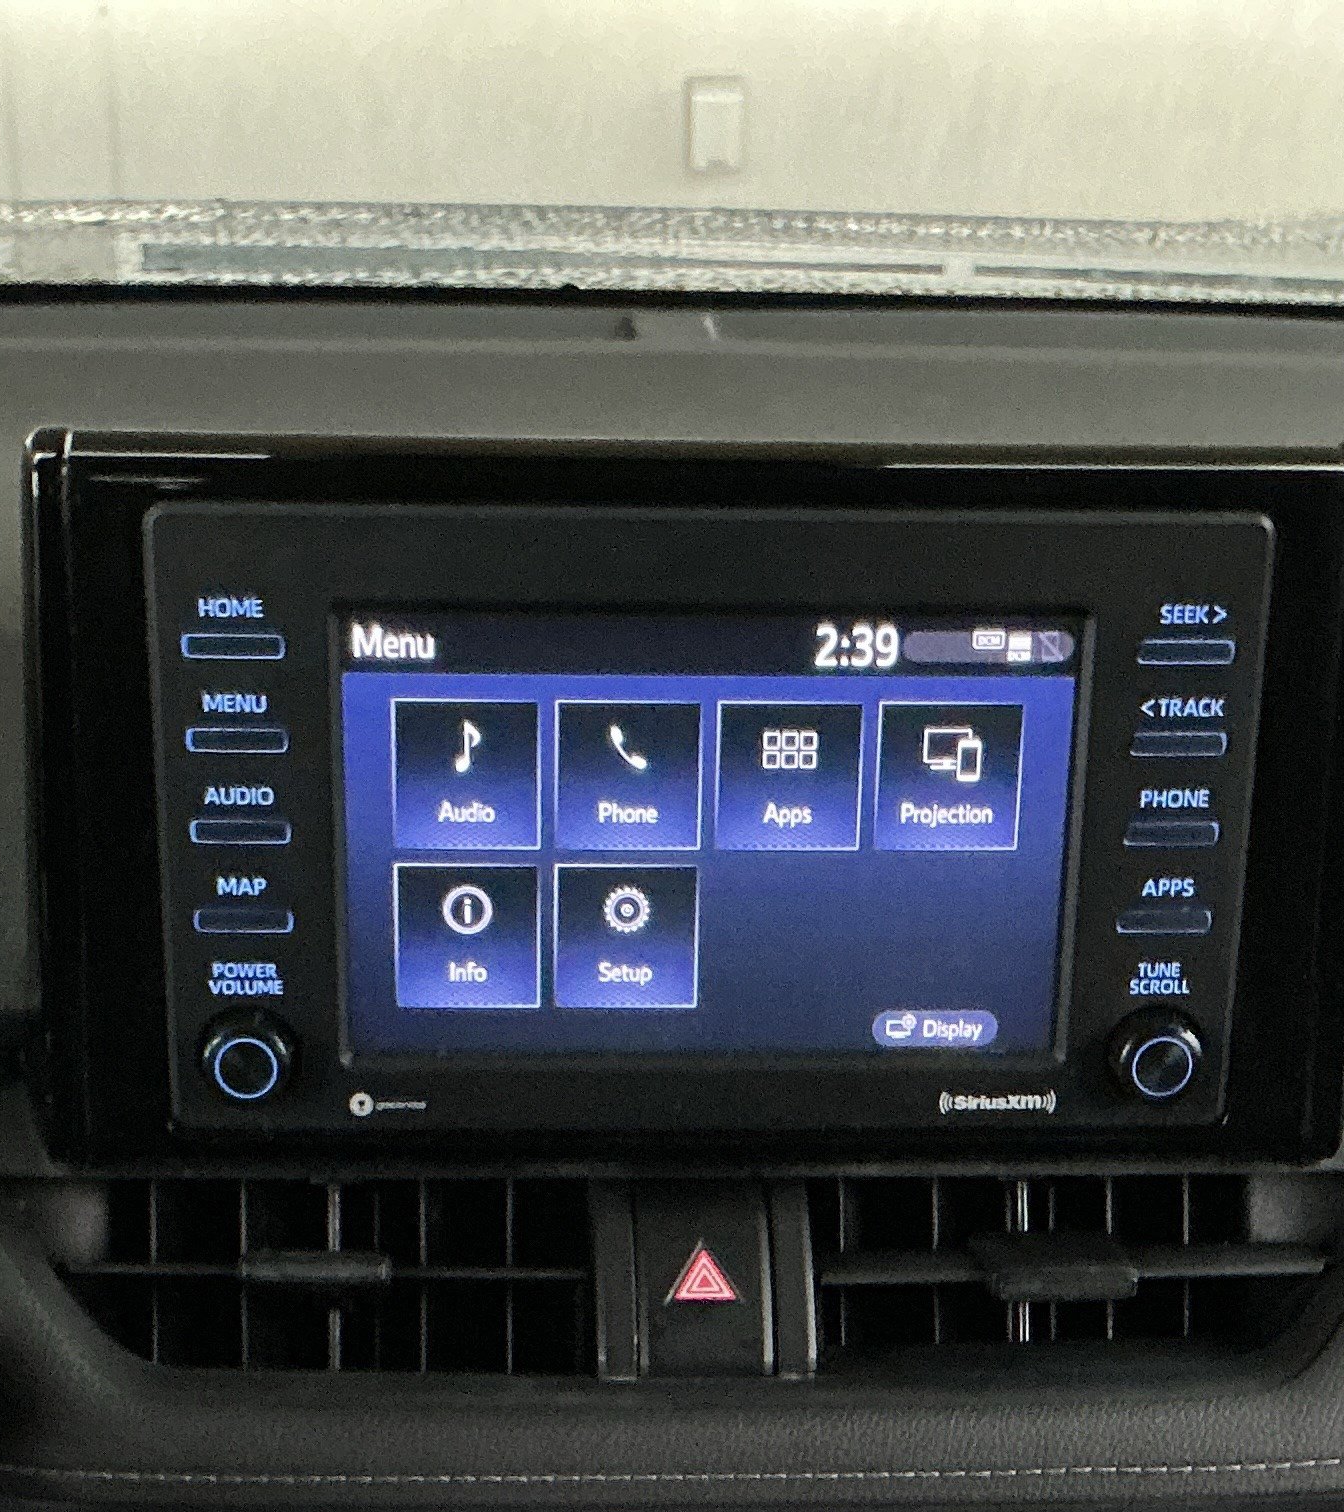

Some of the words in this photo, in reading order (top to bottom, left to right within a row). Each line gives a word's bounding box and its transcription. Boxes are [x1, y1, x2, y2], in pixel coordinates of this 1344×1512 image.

[197, 597, 264, 618] HOME
[350, 622, 436, 660] Menu
[813, 622, 900, 667] 2:39
[201, 693, 268, 714] MENU
[204, 786, 275, 806] AUDIO
[1140, 789, 1210, 809] PHONE
[438, 799, 496, 823] Audio
[597, 800, 659, 824] Phone
[762, 802, 813, 828] Apps
[900, 802, 993, 828] Projection
[215, 877, 267, 896] MAP
[1141, 878, 1195, 897] APPS
[211, 962, 278, 978] POWER
[448, 961, 488, 983] Info
[598, 961, 653, 986] Setup
[1138, 961, 1181, 978] TUNE
[208, 979, 284, 995] VOLUME
[1129, 978, 1190, 995] SCROLL
[922, 1018, 983, 1041] Display
